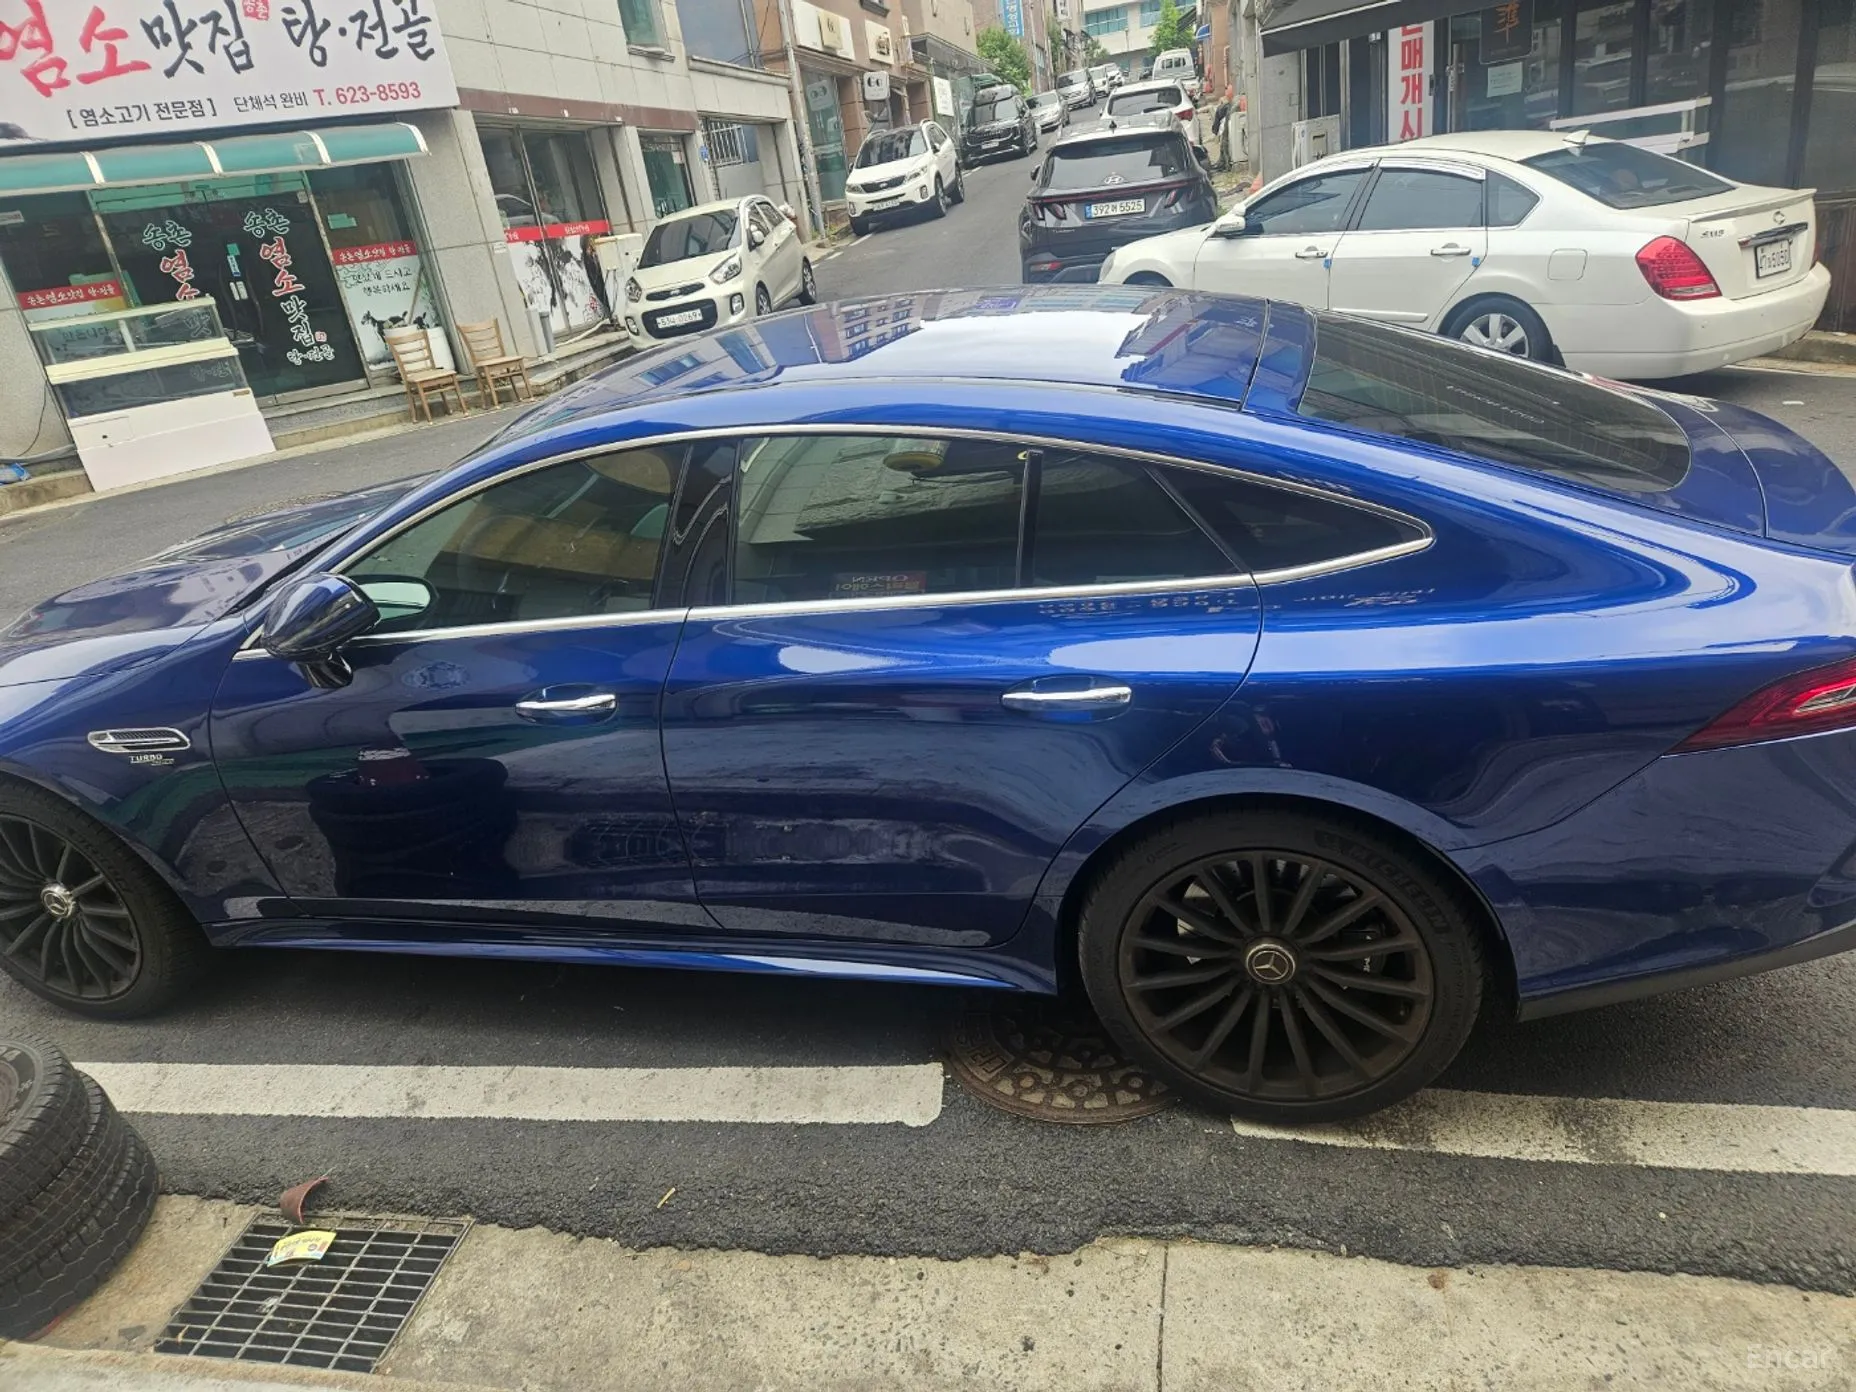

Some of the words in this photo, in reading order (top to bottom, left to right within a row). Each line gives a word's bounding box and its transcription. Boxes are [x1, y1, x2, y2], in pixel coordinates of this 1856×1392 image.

[234, 96, 277, 113] 단체석
[279, 91, 309, 109] 완비
[336, 81, 422, 105] 623-8593
[80, 103, 151, 127] 염소고기
[154, 98, 206, 121] 전문점
[129, 753, 163, 764] TURBO
